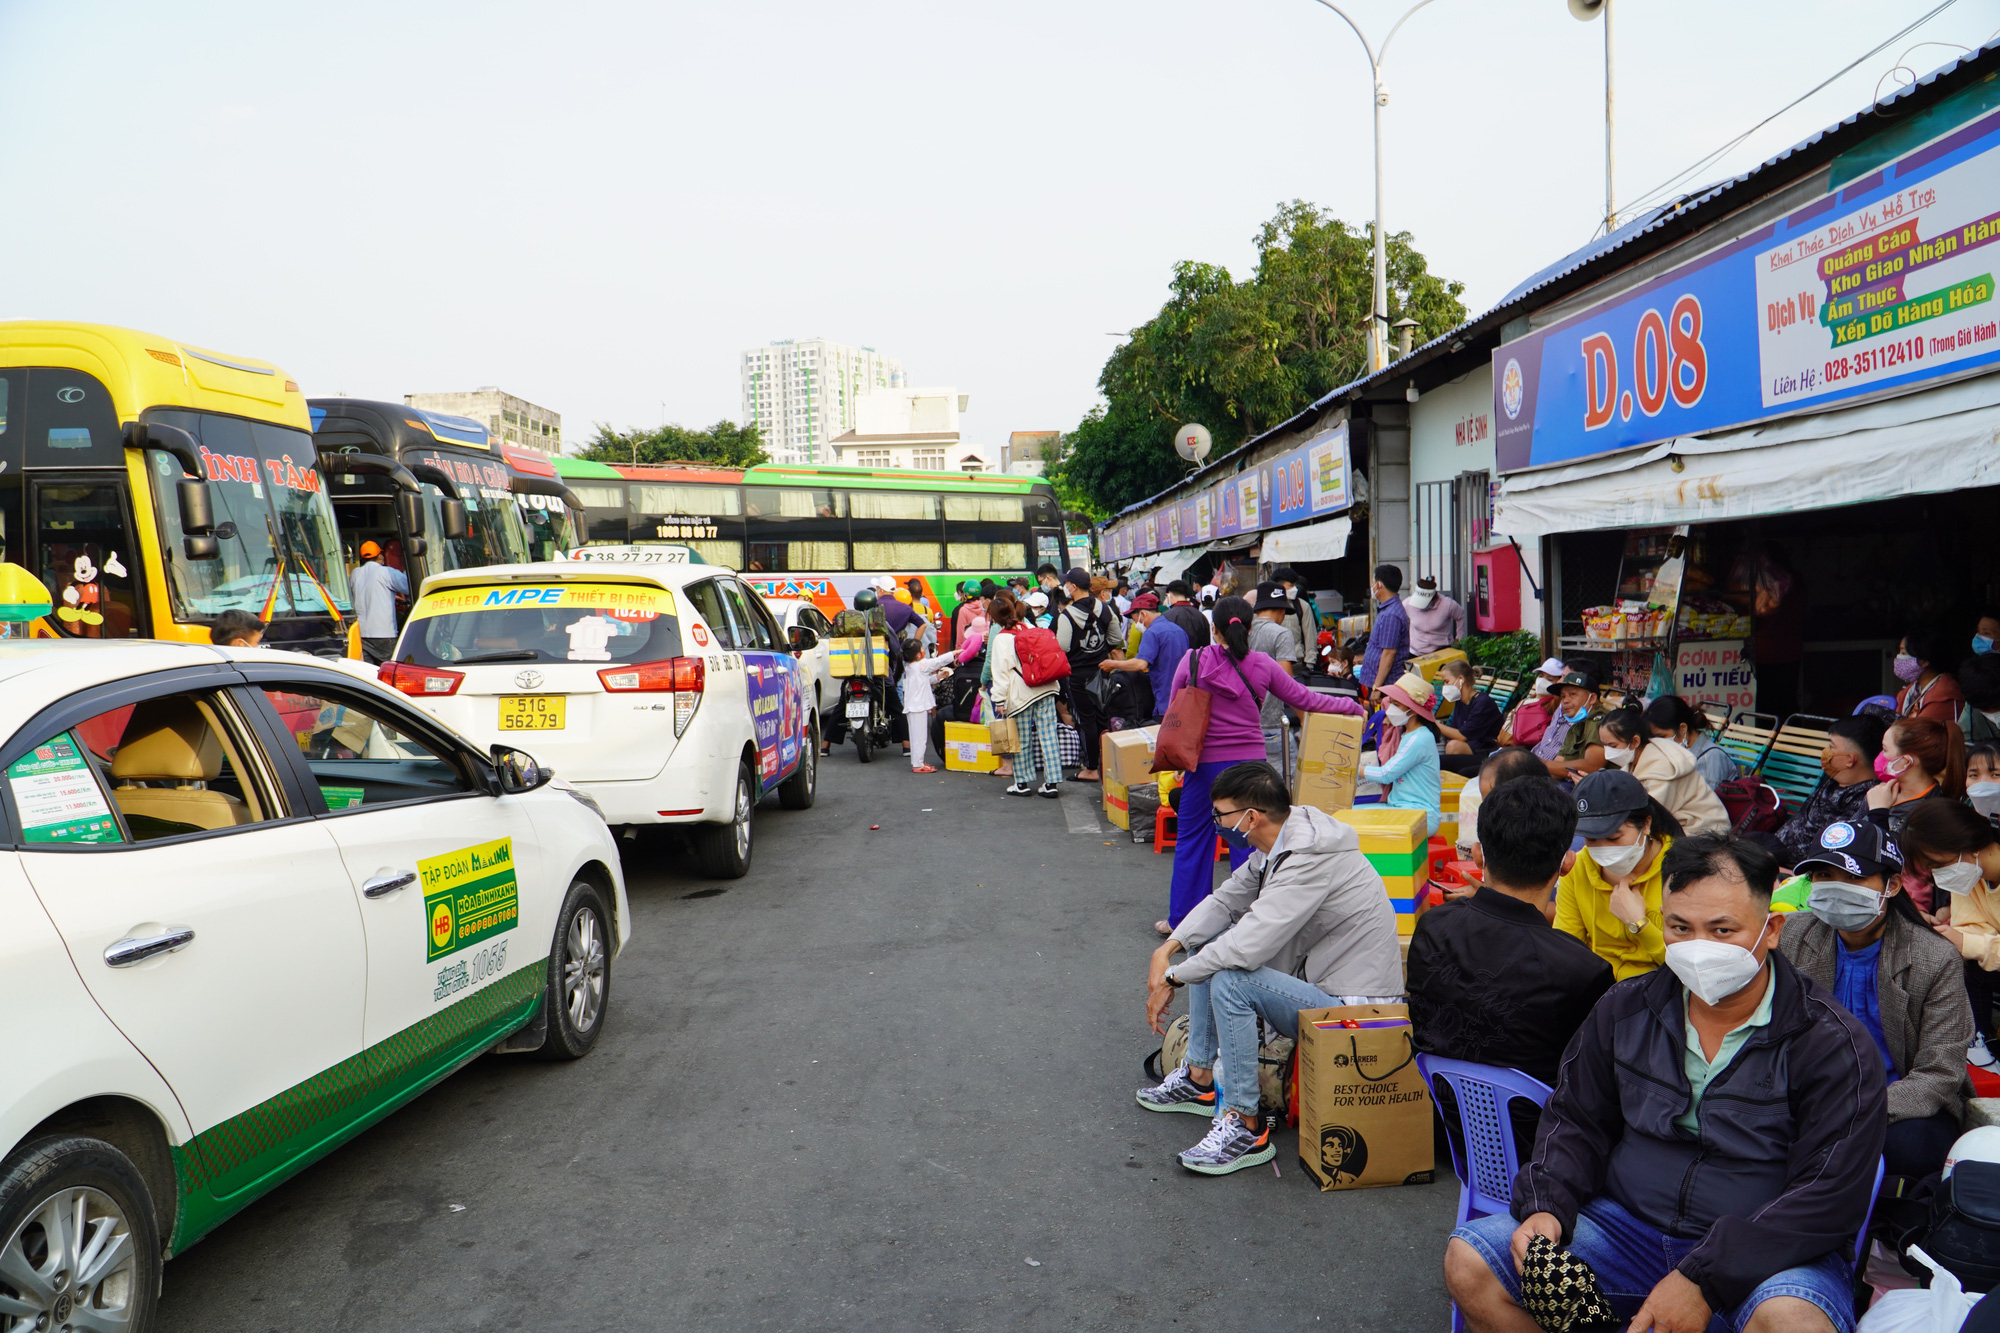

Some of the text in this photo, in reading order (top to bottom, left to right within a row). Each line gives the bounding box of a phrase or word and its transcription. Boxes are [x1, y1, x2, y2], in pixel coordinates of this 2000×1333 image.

[1770, 252, 1793, 269] Khai
[1797, 236, 1824, 257] Thác
[1859, 213, 1877, 235] Vụ
[1823, 228, 1912, 275] Quảng Cáo
[1830, 272, 1861, 295] Kho
[1866, 256, 1904, 282] Giao
[1908, 235, 1957, 266] Nhận
[1767, 290, 1816, 334] Dịch Vụ
[1827, 284, 1897, 322] Ẩm Thực
[1836, 280, 1988, 345] Xếp Dỡ Hàng Hóa
[1581, 293, 1708, 432] D.08
[1773, 374, 1798, 397] Liên
[1799, 368, 1816, 393] Hệ
[1824, 336, 1924, 382] 028-35112410
[1929, 337, 1956, 361] (Trong
[1957, 326, 1973, 350] Giờ
[1974, 321, 1997, 344] Hành
[1455, 416, 1466, 447] NHÀ
[1467, 412, 1474, 447] VỆ
[1475, 414, 1488, 441] SINH
[184, 446, 322, 494] ÌNH TÂM
[1277, 458, 1305, 513] D.09
[706, 526, 718, 538] 77
[644, 552, 663, 563] 27
[667, 553, 686, 564] 27
[430, 587, 656, 611] ĐÈN LED MPE THIẾT BỊ ĐIỆN
[765, 578, 828, 596] TÂM
[1679, 647, 1717, 668] CƠM
[1683, 666, 1751, 689] HỦ TIẾU
[517, 698, 546, 713] 51G
[1726, 692, 1754, 708] BÒ
[505, 714, 558, 729] 562.79
[35, 748, 56, 761] 1055
[422, 866, 442, 891] TẬP
[444, 859, 469, 880] ĐOÀN
[457, 895, 476, 915] HÒA
[476, 889, 495, 908] BÌNH
[434, 914, 450, 937] HB
[458, 906, 518, 939] COOPERATION
[471, 938, 508, 985] 1055
[1333, 1082, 1400, 1095] BEST CHOICE
[1333, 1089, 1424, 1107] FOR YOUR HEALTH
